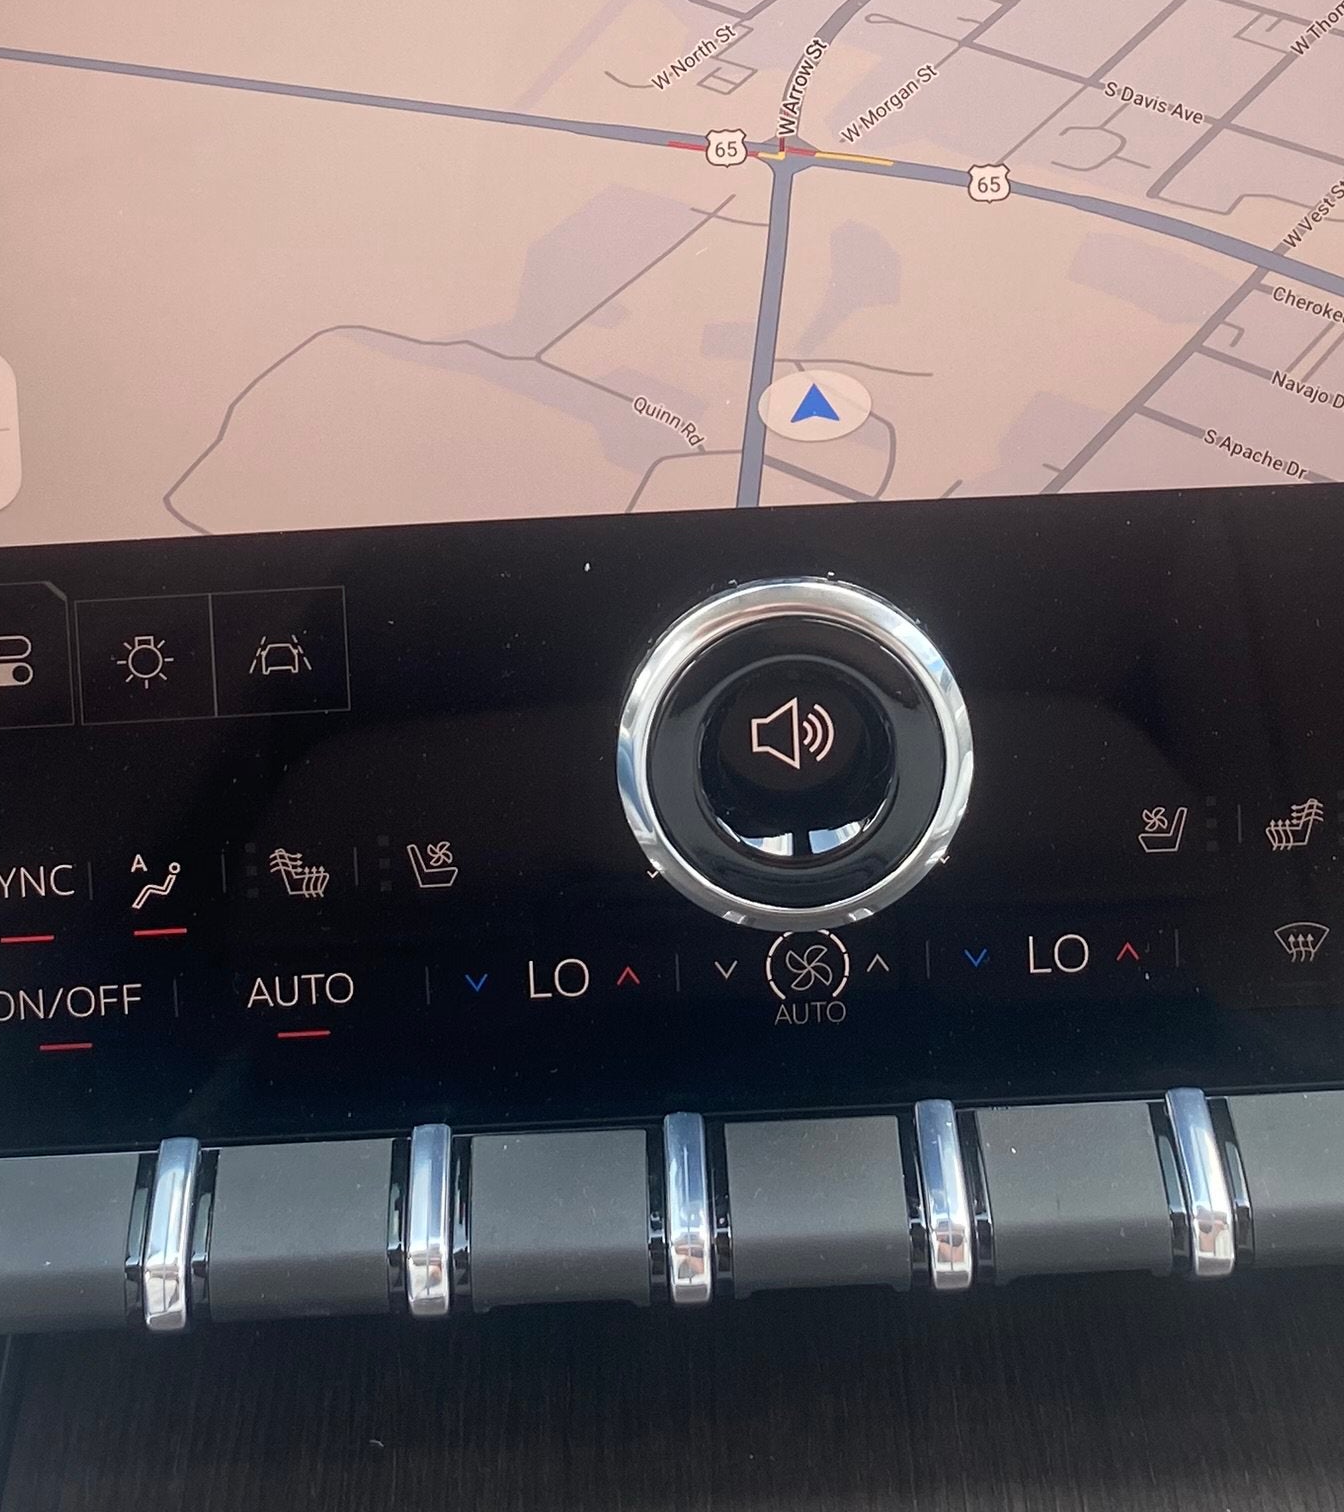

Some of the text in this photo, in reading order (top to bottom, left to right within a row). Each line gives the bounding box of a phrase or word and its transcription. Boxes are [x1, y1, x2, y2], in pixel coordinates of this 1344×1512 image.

[841, 63, 938, 144] W Morgan St
[1104, 81, 1204, 124] S Davis Ave
[715, 142, 737, 156] 65
[977, 176, 1000, 194] 65
[1272, 372, 1330, 404] Navajo
[633, 396, 705, 447] Quinn Rd
[1204, 428, 1307, 480] S Apache Dr
[1028, 934, 1090, 974] LO
[248, 972, 355, 1007] AUTO
[528, 959, 590, 999] LO
[774, 1001, 847, 1026] AUTO
